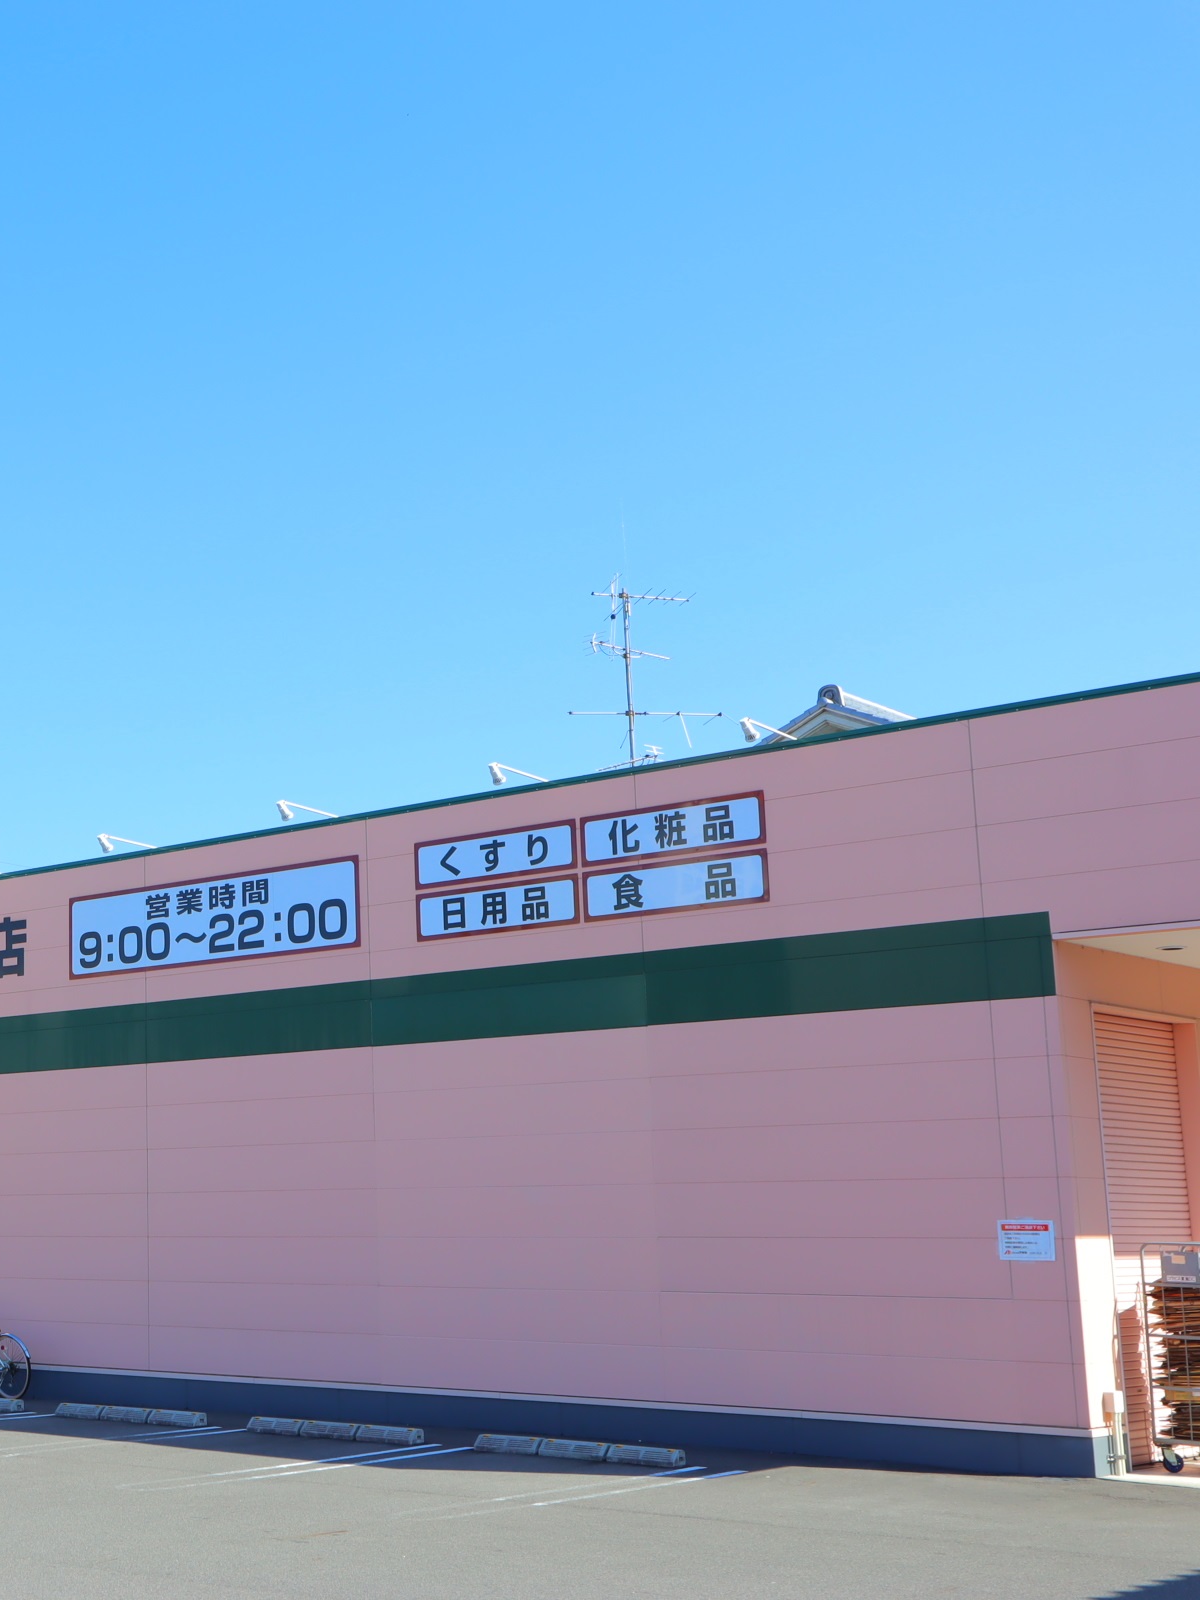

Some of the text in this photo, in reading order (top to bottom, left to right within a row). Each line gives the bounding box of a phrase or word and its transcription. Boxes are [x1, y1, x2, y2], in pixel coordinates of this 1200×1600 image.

[607, 804, 735, 856] 化粧品
[439, 834, 549, 877] くすり
[145, 878, 270, 921] 営業時間
[441, 886, 550, 931] 日用品
[611, 862, 737, 912] 食品
